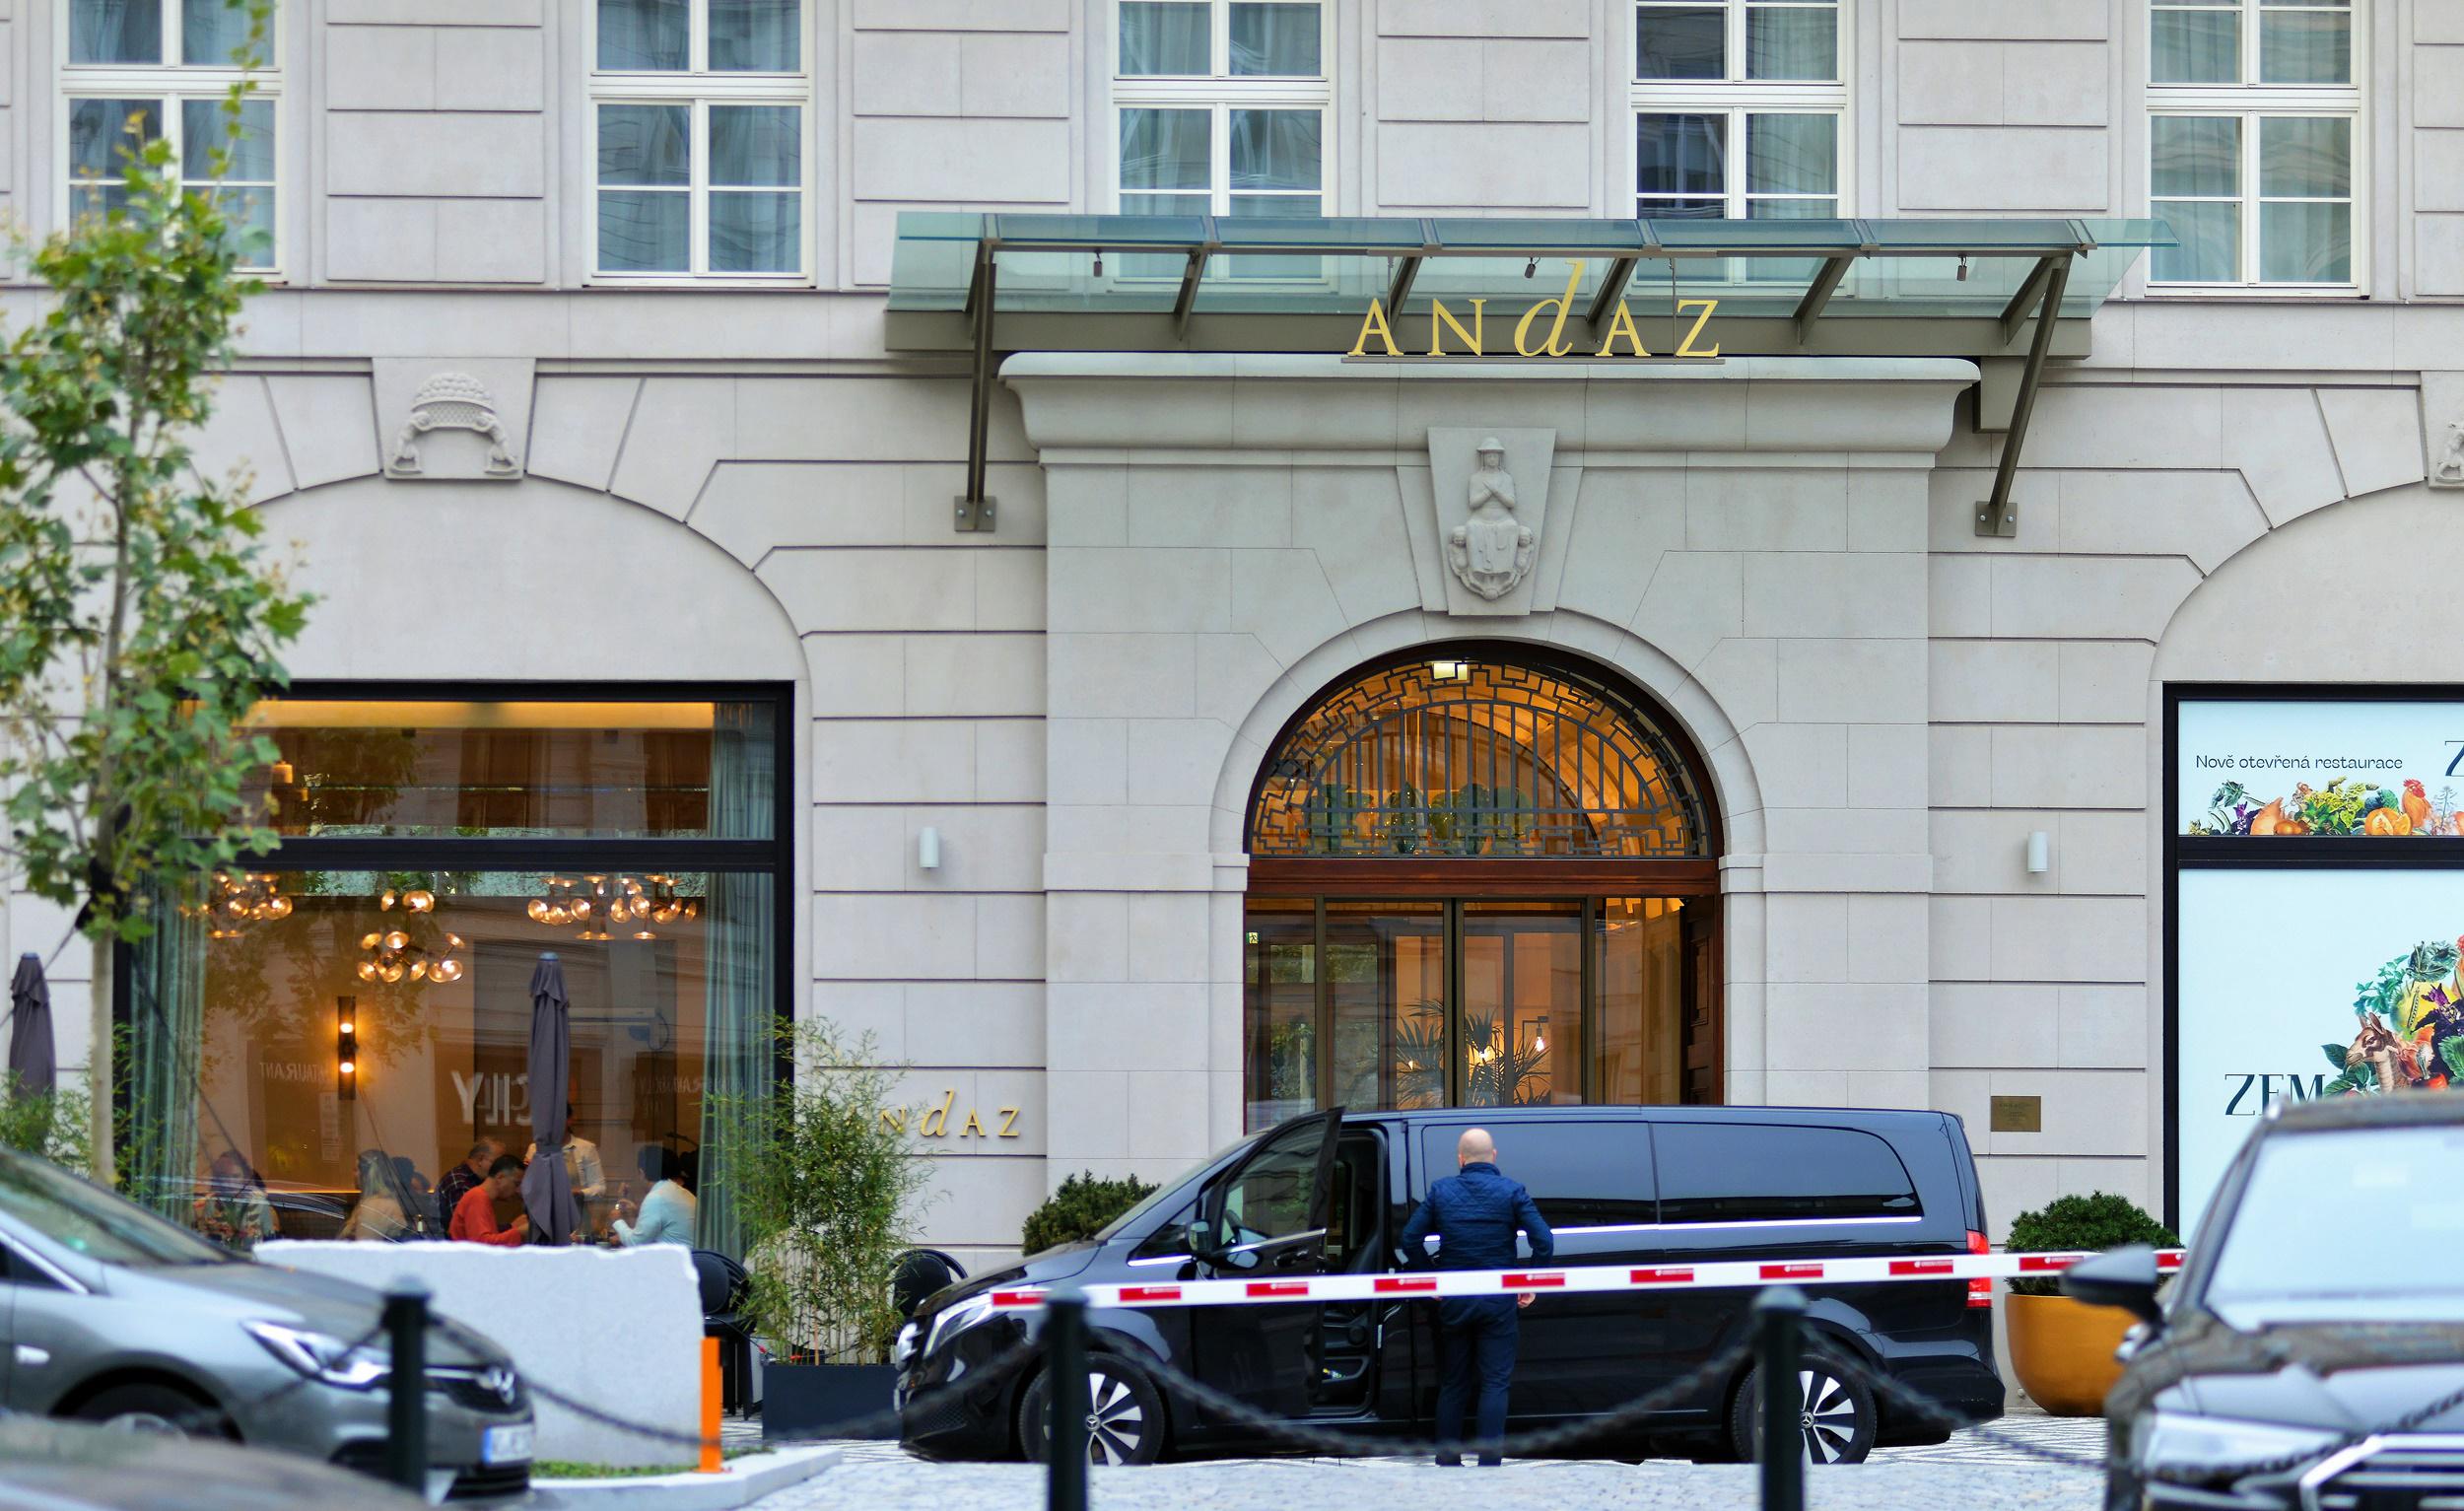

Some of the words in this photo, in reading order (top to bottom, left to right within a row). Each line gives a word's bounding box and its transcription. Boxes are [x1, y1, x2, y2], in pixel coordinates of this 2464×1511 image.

[1347, 259, 1720, 357] ANdAZ
[2196, 755, 2234, 769] Nově
[2239, 755, 2310, 769] otevřená
[2316, 756, 2403, 769] restaurace
[845, 1088, 1021, 1137] NdAZ
